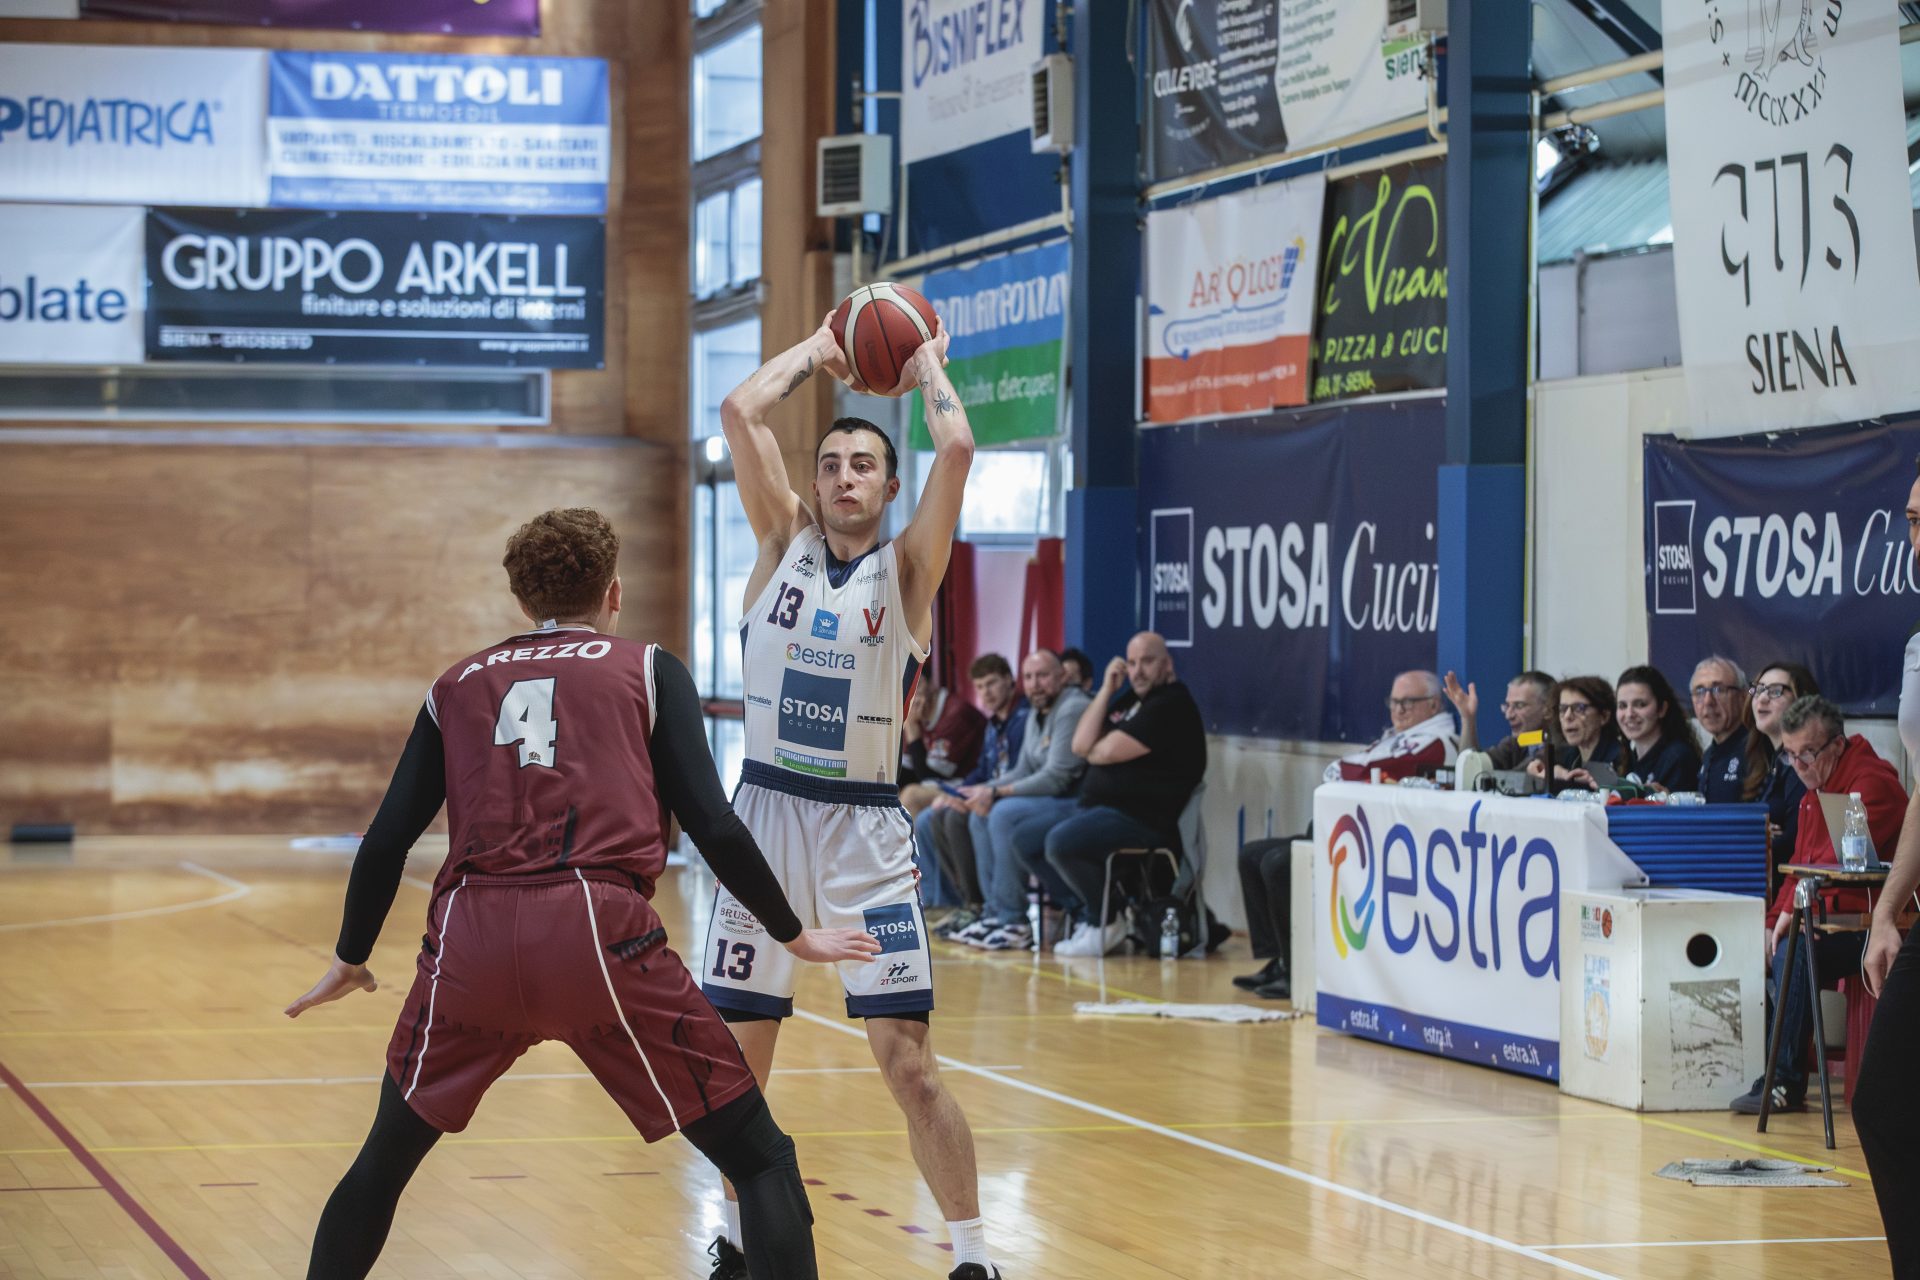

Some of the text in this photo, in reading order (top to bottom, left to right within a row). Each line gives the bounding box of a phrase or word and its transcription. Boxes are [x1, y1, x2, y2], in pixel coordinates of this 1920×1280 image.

[311, 63, 562, 105] DATTOLI
[161, 234, 586, 297] GRUPPO ARKELL
[302, 293, 585, 321] finiture e soluzioni di interni
[1324, 333, 1376, 363] PIZZA
[1746, 324, 1858, 394] SIENA
[1659, 544, 1692, 571] STOSA
[1703, 511, 1842, 598] STOSA
[1154, 562, 1190, 594] STOSA
[1201, 522, 1329, 629] STOSA
[767, 581, 804, 630] 13
[859, 636, 885, 644] VIRTUS
[458, 640, 612, 683] AREZZO
[802, 644, 855, 670] estra
[494, 677, 557, 768] 4
[782, 697, 844, 723] STOSA
[788, 719, 836, 733] CUCINE
[1382, 799, 1560, 981] estra
[720, 907, 760, 924] BRUSC
[869, 920, 916, 938] STOSA
[712, 938, 756, 981] 13
[880, 975, 918, 986] 2T SPORT
[1350, 1008, 1379, 1032] estra.it
[1423, 1026, 1454, 1049] estra.it
[1503, 1043, 1540, 1067] estra.it
